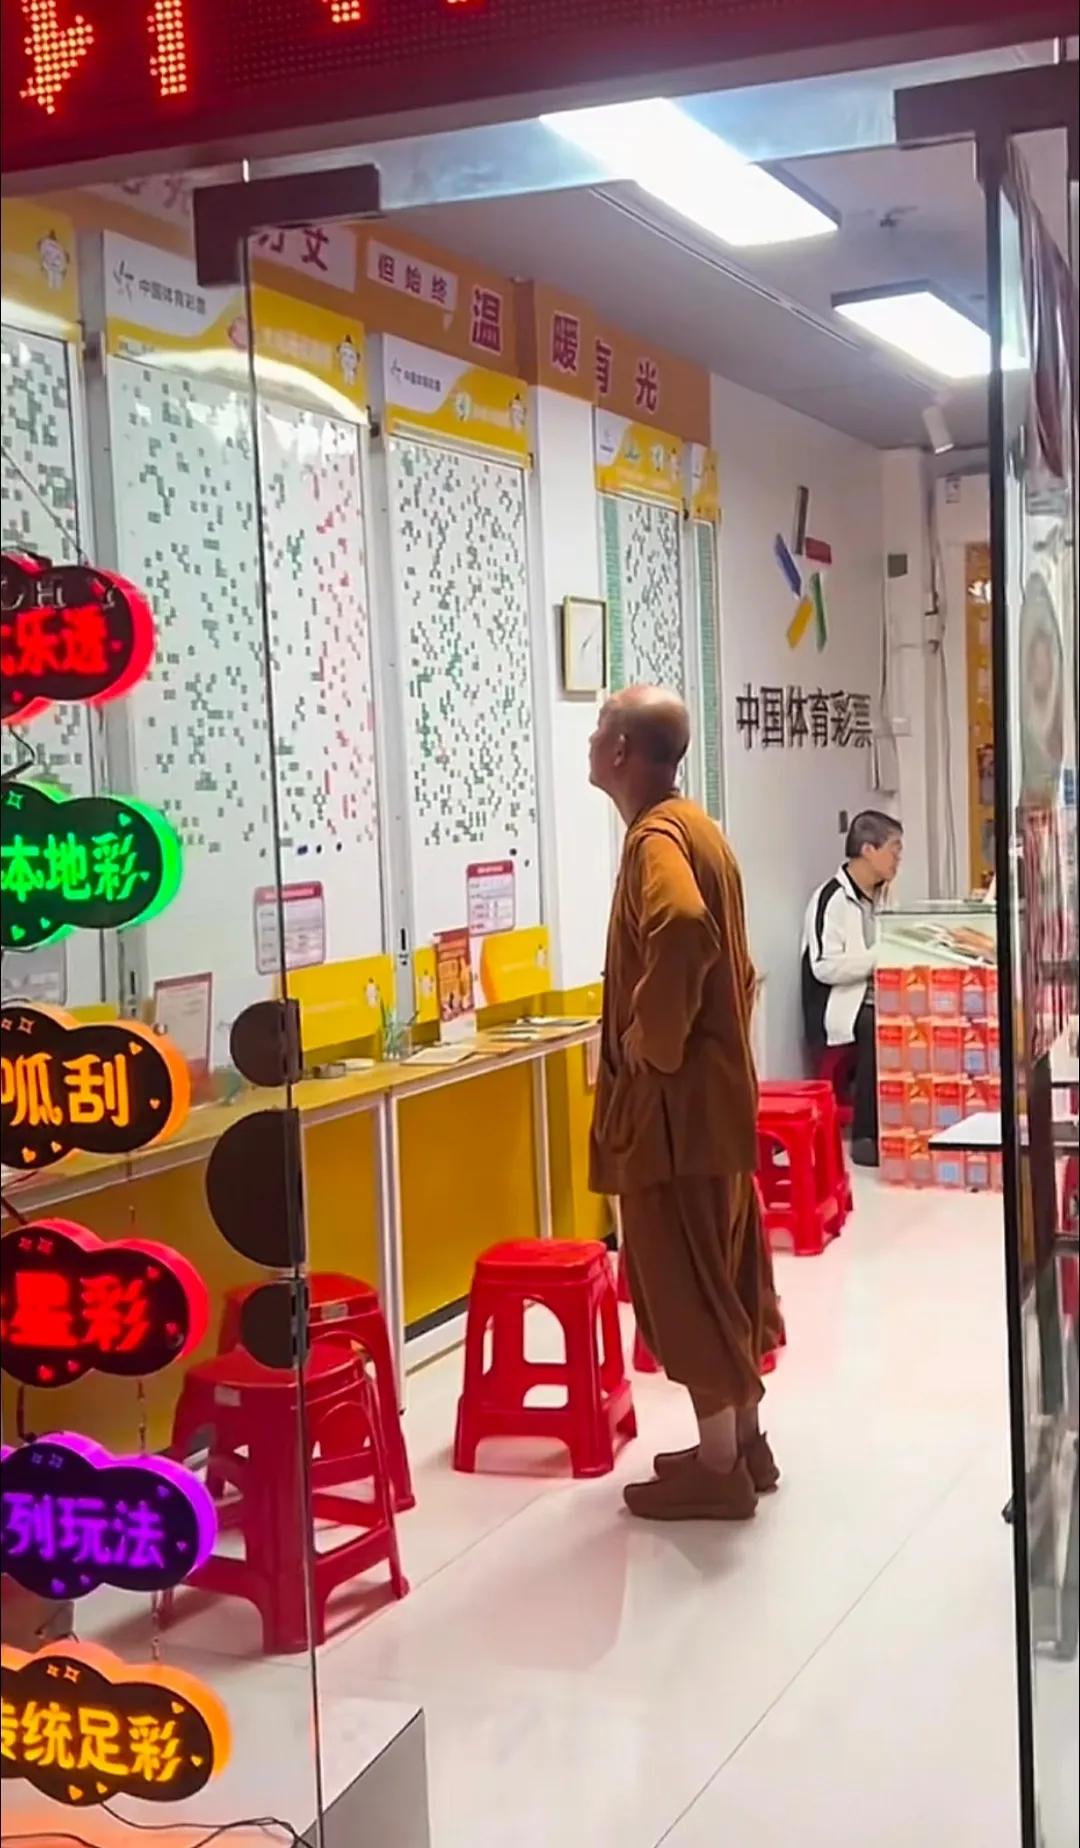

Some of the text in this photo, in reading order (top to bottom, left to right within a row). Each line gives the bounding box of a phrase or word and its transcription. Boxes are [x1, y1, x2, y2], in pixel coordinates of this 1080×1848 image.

[378, 253, 448, 305] 但始终
[736, 682, 873, 750] 中国体育彩票
[1, 832, 138, 903] 本地彩
[1, 1270, 149, 1353] 星彩
[1, 1492, 165, 1569] 列玩法
